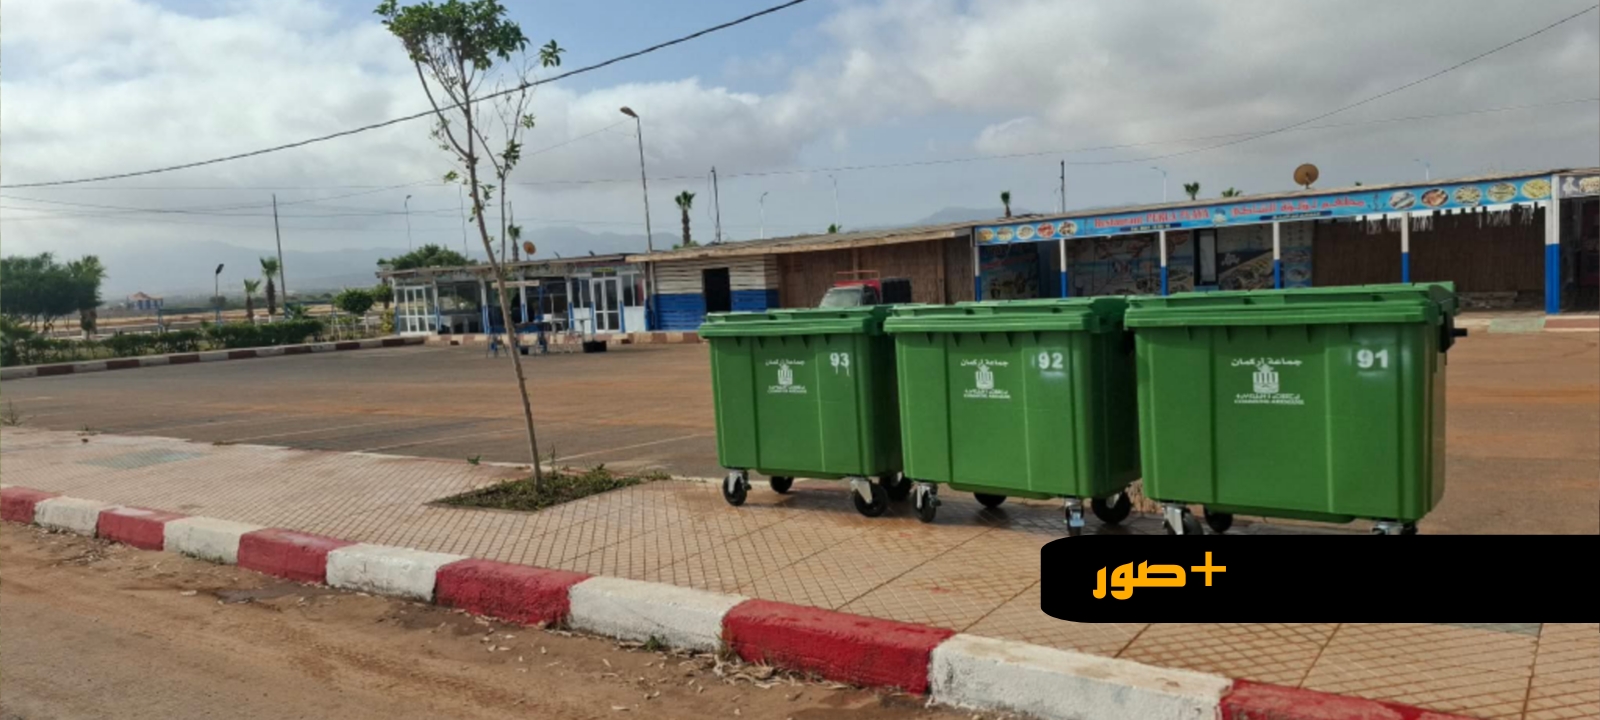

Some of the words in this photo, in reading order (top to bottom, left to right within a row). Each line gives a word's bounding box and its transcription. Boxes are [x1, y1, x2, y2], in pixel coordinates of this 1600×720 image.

[829, 352, 850, 368] 93
[1038, 352, 1063, 369] 92
[1267, 357, 1303, 367] جماعة
[1357, 349, 1389, 368] 91
